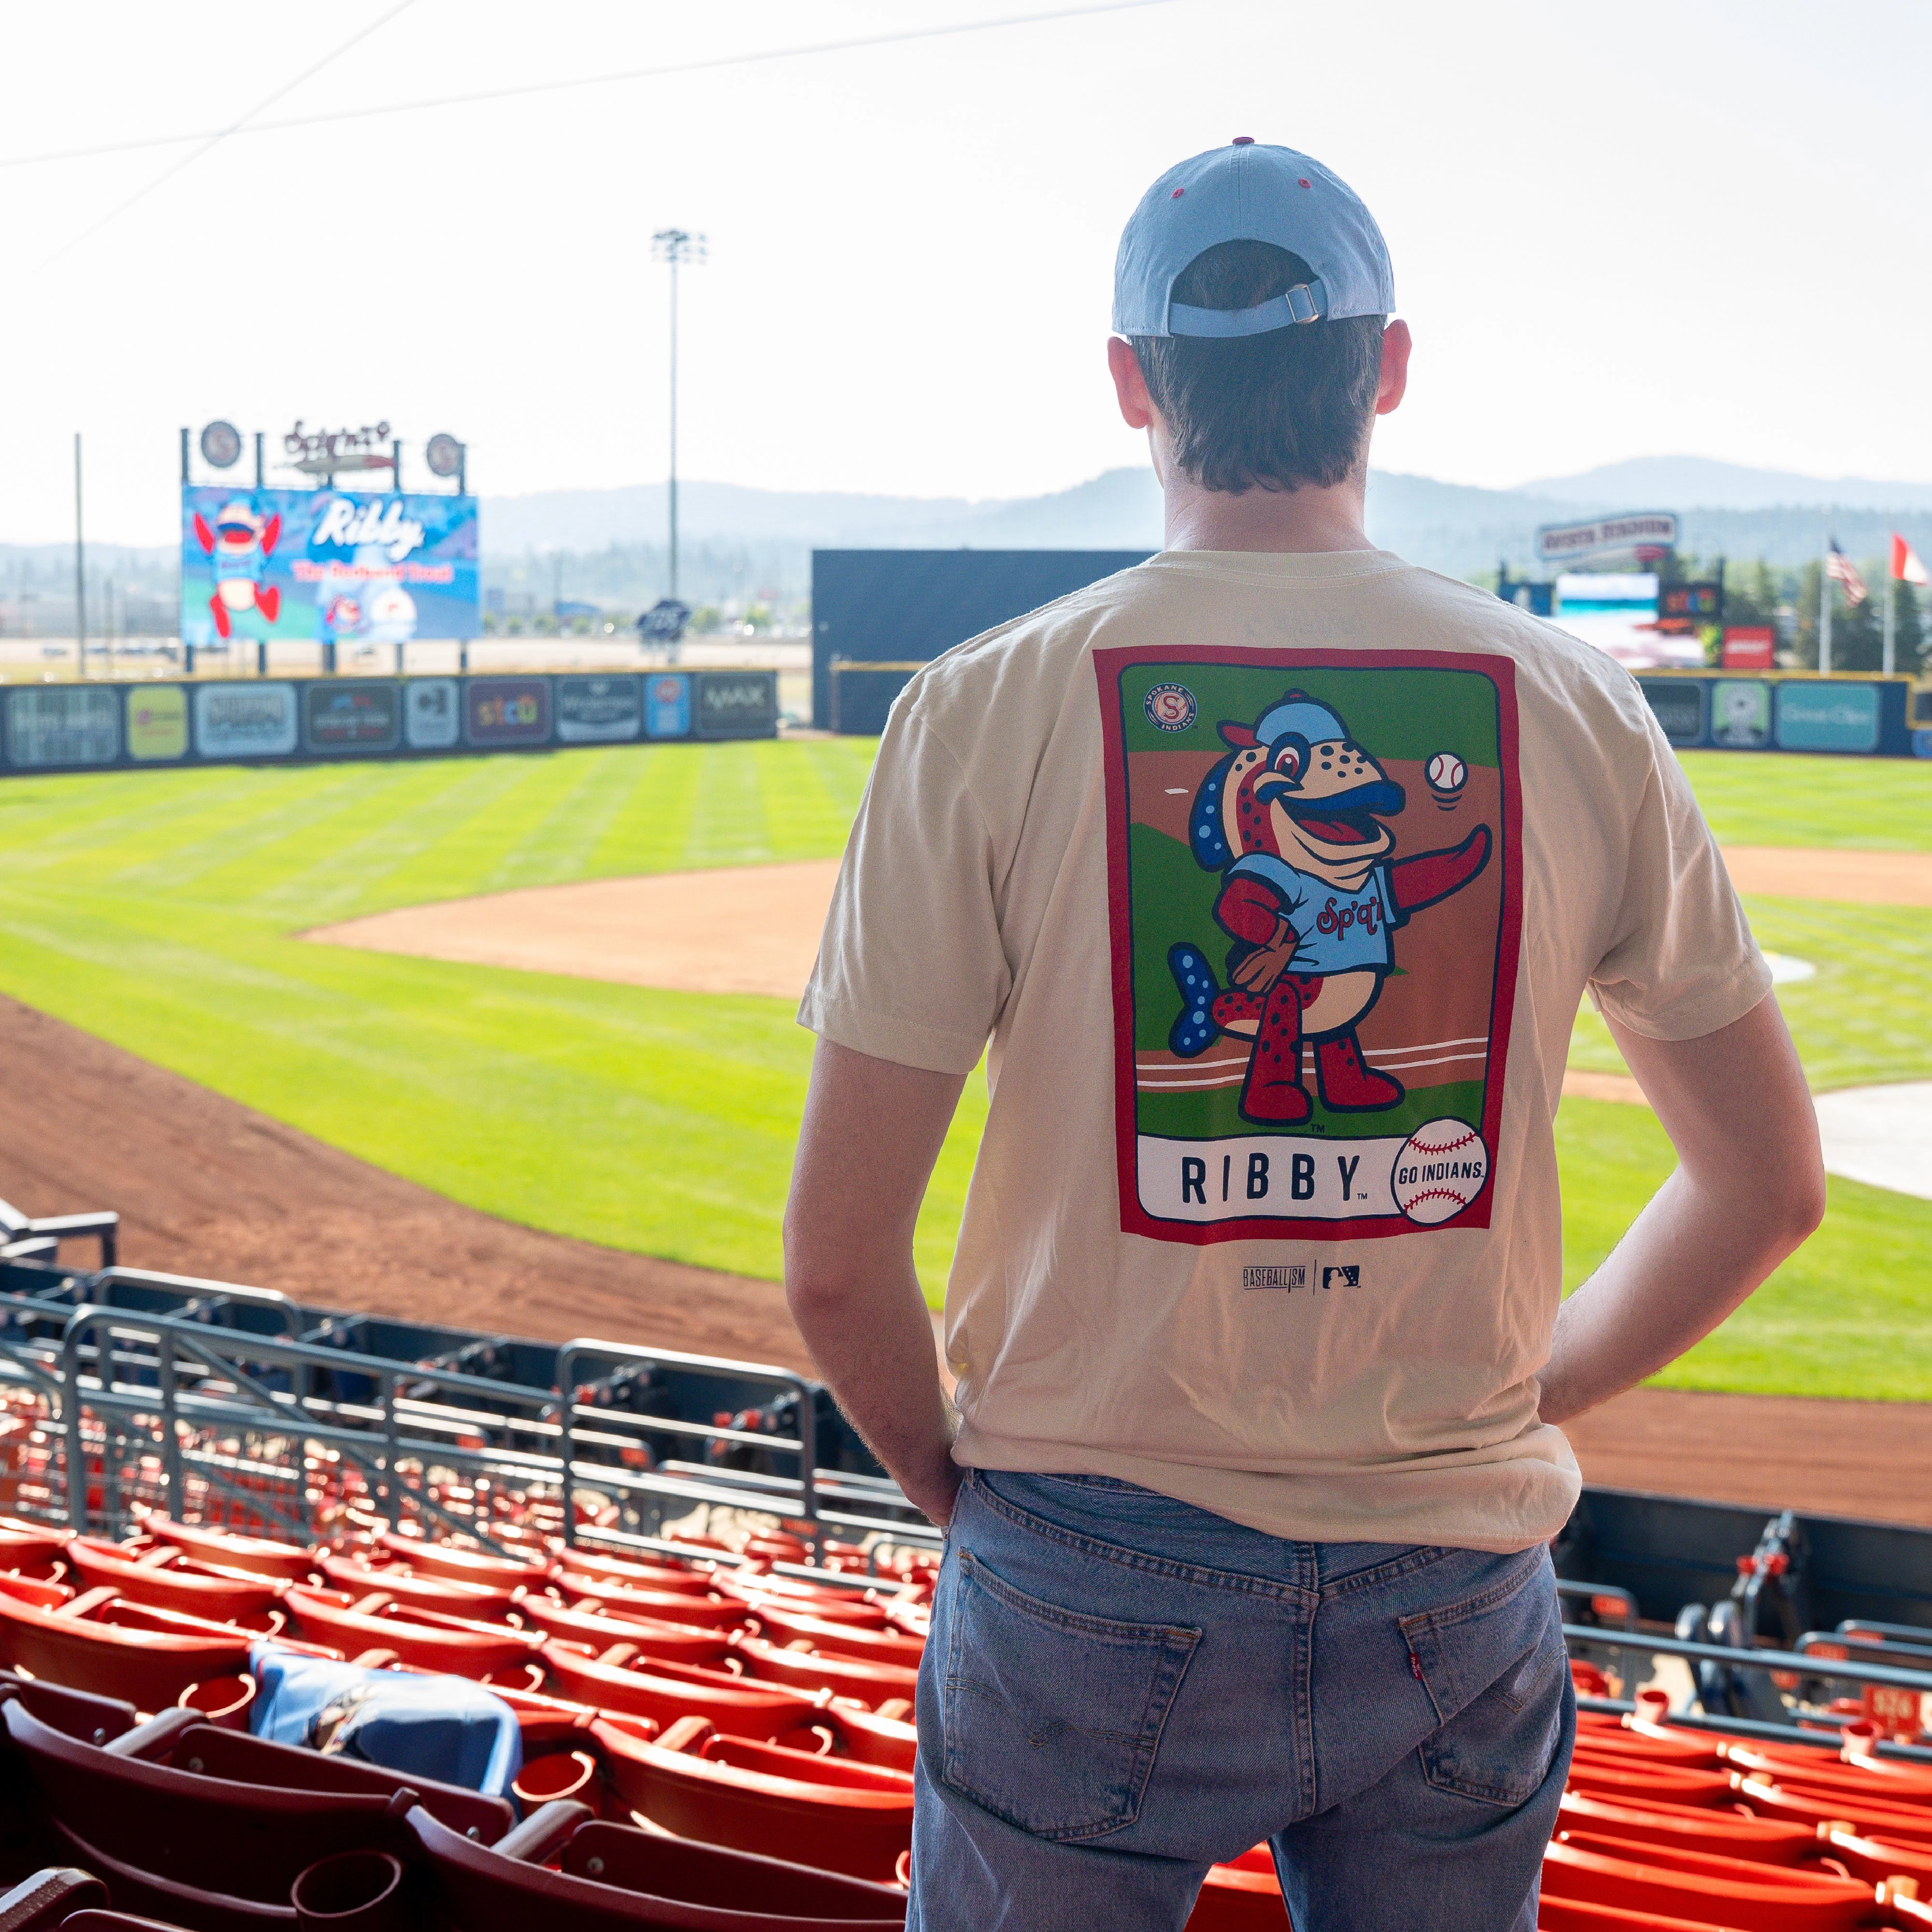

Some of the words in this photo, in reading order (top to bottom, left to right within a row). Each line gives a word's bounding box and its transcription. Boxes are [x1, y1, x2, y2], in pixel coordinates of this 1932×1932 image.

[313, 497, 426, 563] Ribby
[1146, 685, 1183, 705] SPOKANE
[1163, 696, 1179, 720] S
[1161, 712, 1194, 731] INDIANS
[1182, 1152, 1360, 1205] RIBBY
[1399, 1166, 1418, 1184] GO
[1421, 1161, 1482, 1182] INDIANS
[1243, 1268, 1306, 1293] BASEBALLISM
